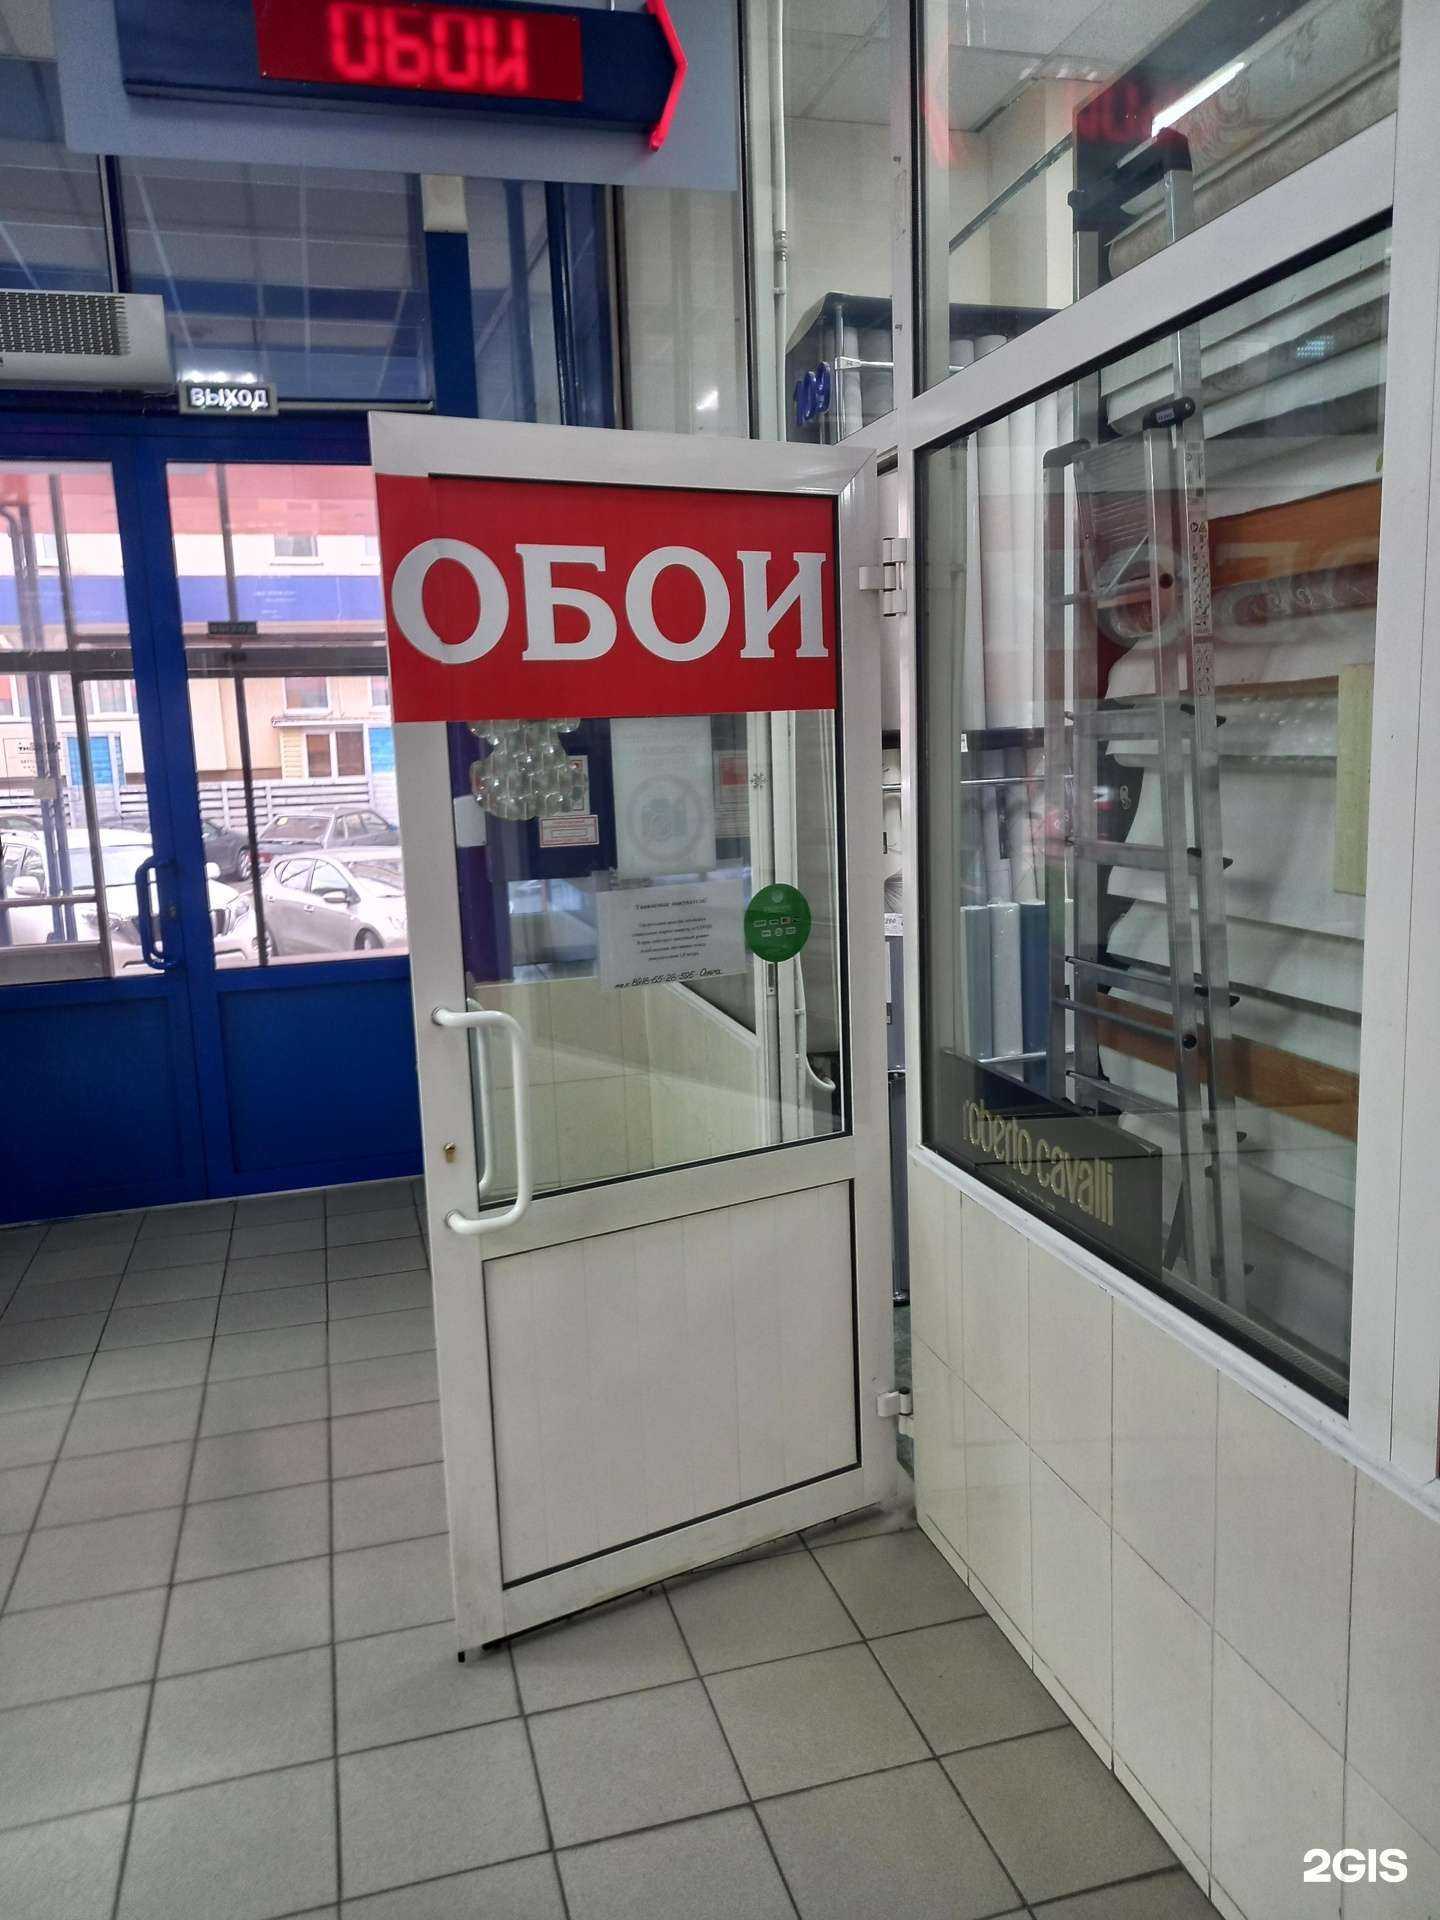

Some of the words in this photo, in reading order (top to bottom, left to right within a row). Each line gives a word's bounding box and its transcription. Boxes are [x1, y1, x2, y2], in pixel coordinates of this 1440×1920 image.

[328, 2, 529, 91] ОБОИ
[190, 387, 269, 410] ВЫХОД
[391, 537, 829, 664] ОБОИ
[961, 1098, 1033, 1177] roberto
[1036, 1138, 1114, 1227] cavalli
